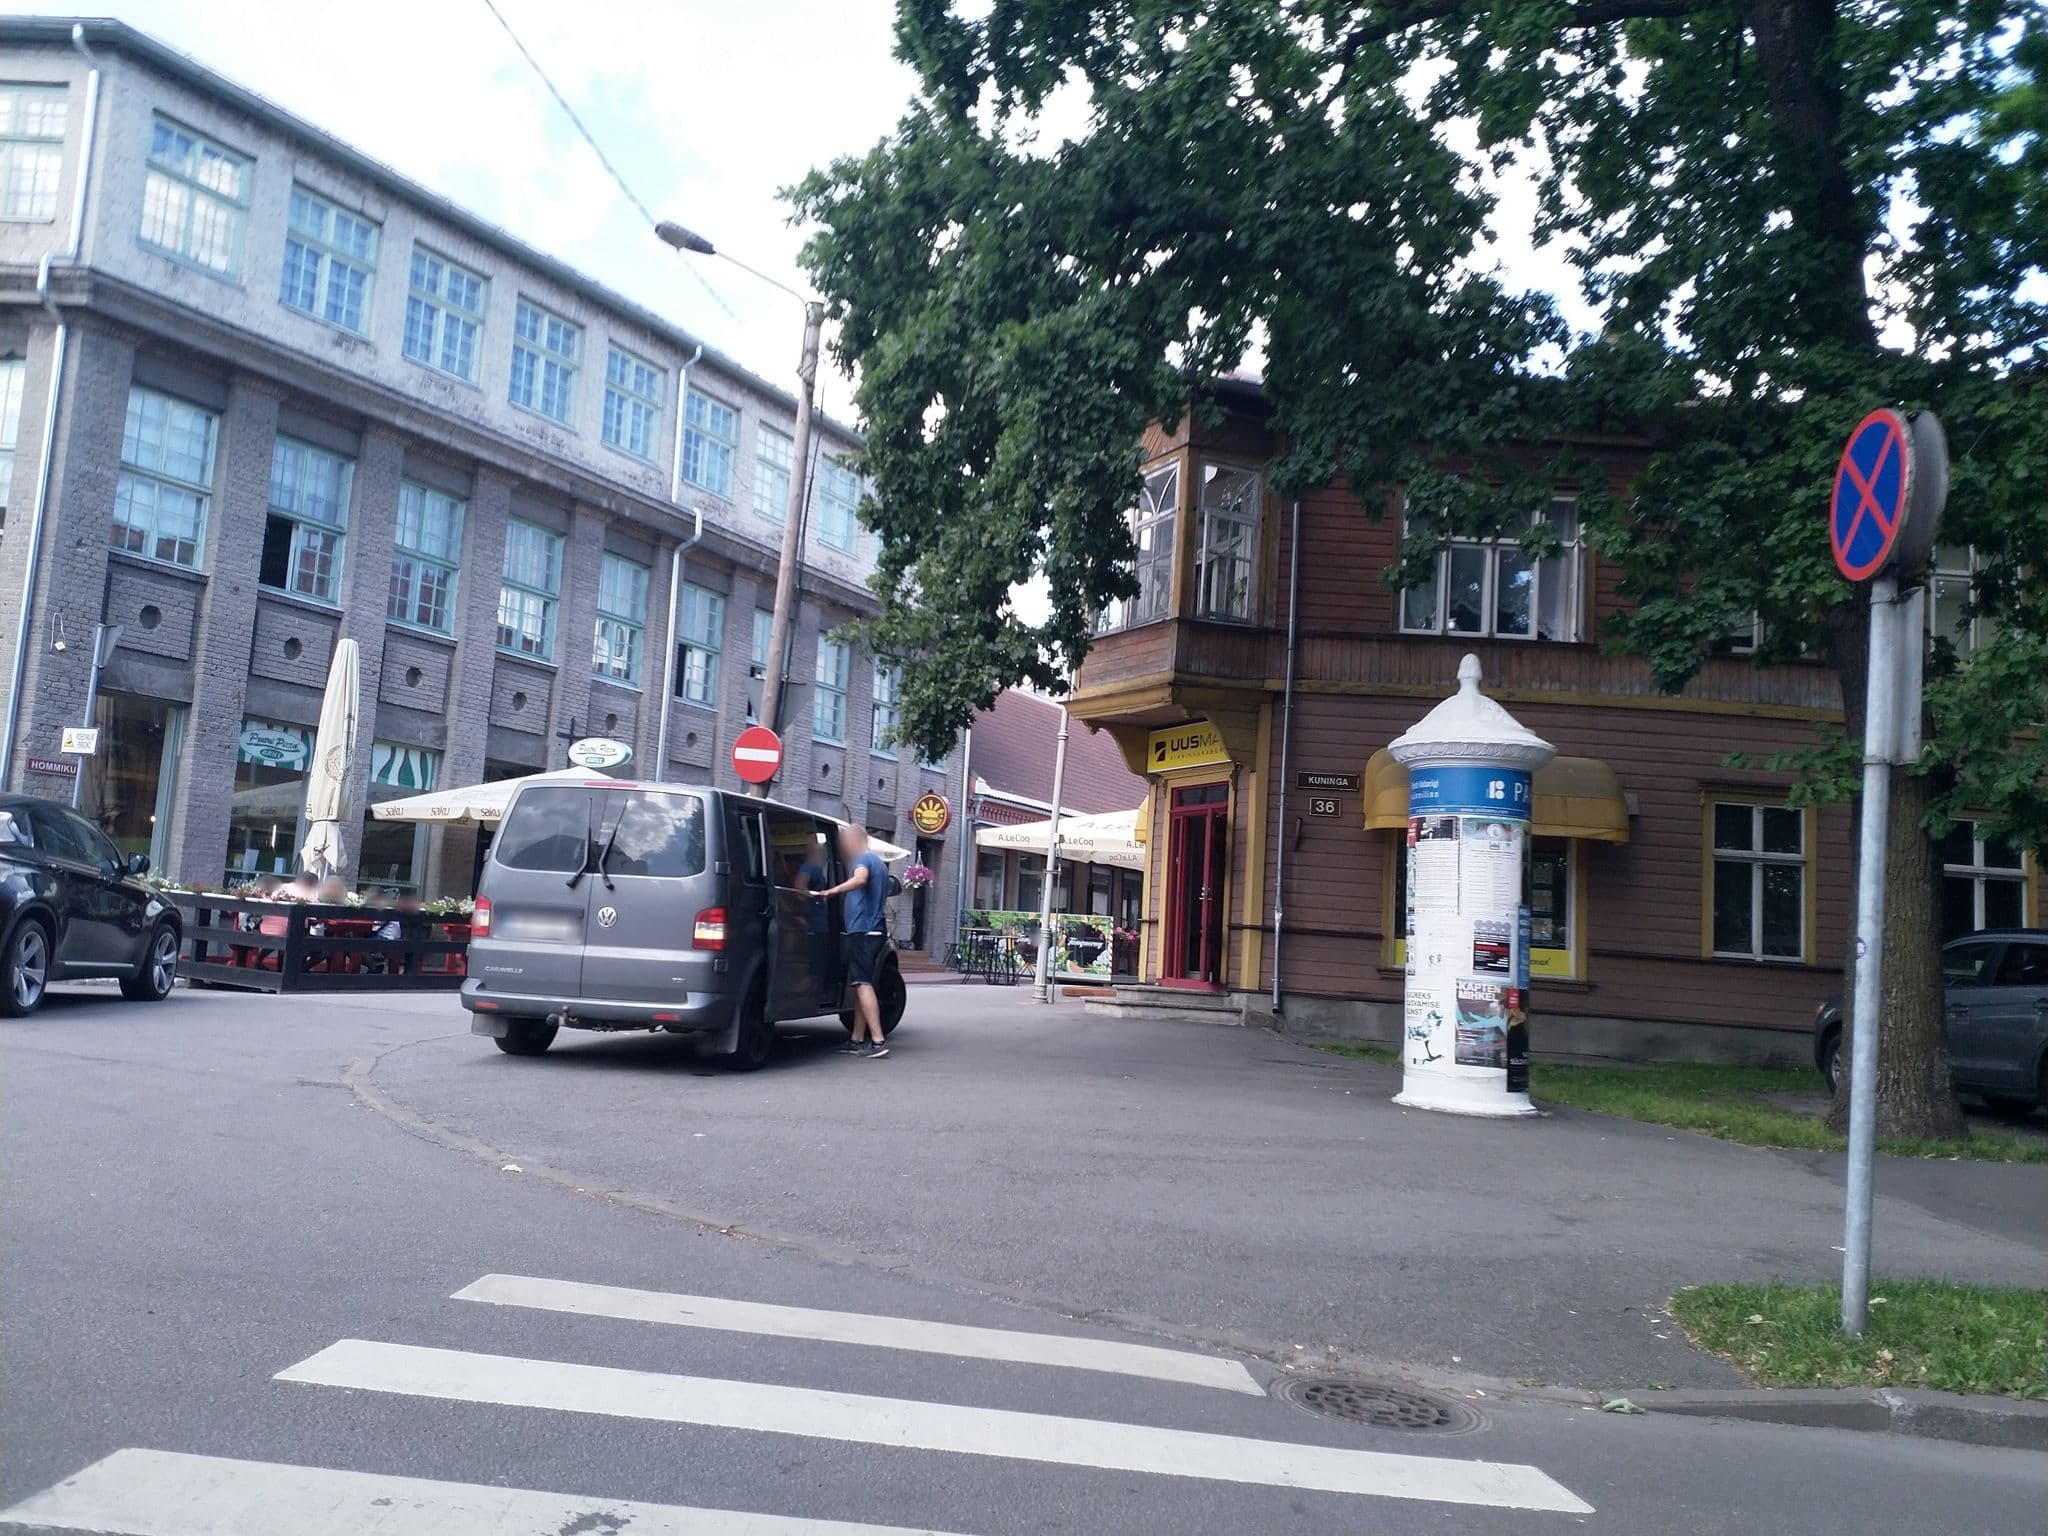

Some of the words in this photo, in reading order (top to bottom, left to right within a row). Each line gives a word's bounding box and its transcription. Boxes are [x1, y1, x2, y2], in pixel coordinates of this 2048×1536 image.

[31, 760, 77, 774] HOMMIKU
[1308, 776, 1349, 786] KUNINGA
[1315, 800, 1335, 813] 36
[485, 966, 524, 974] CARAVELLE
[1457, 981, 1501, 994] KAPTEN
[1458, 990, 1499, 1001] MIHKEL
